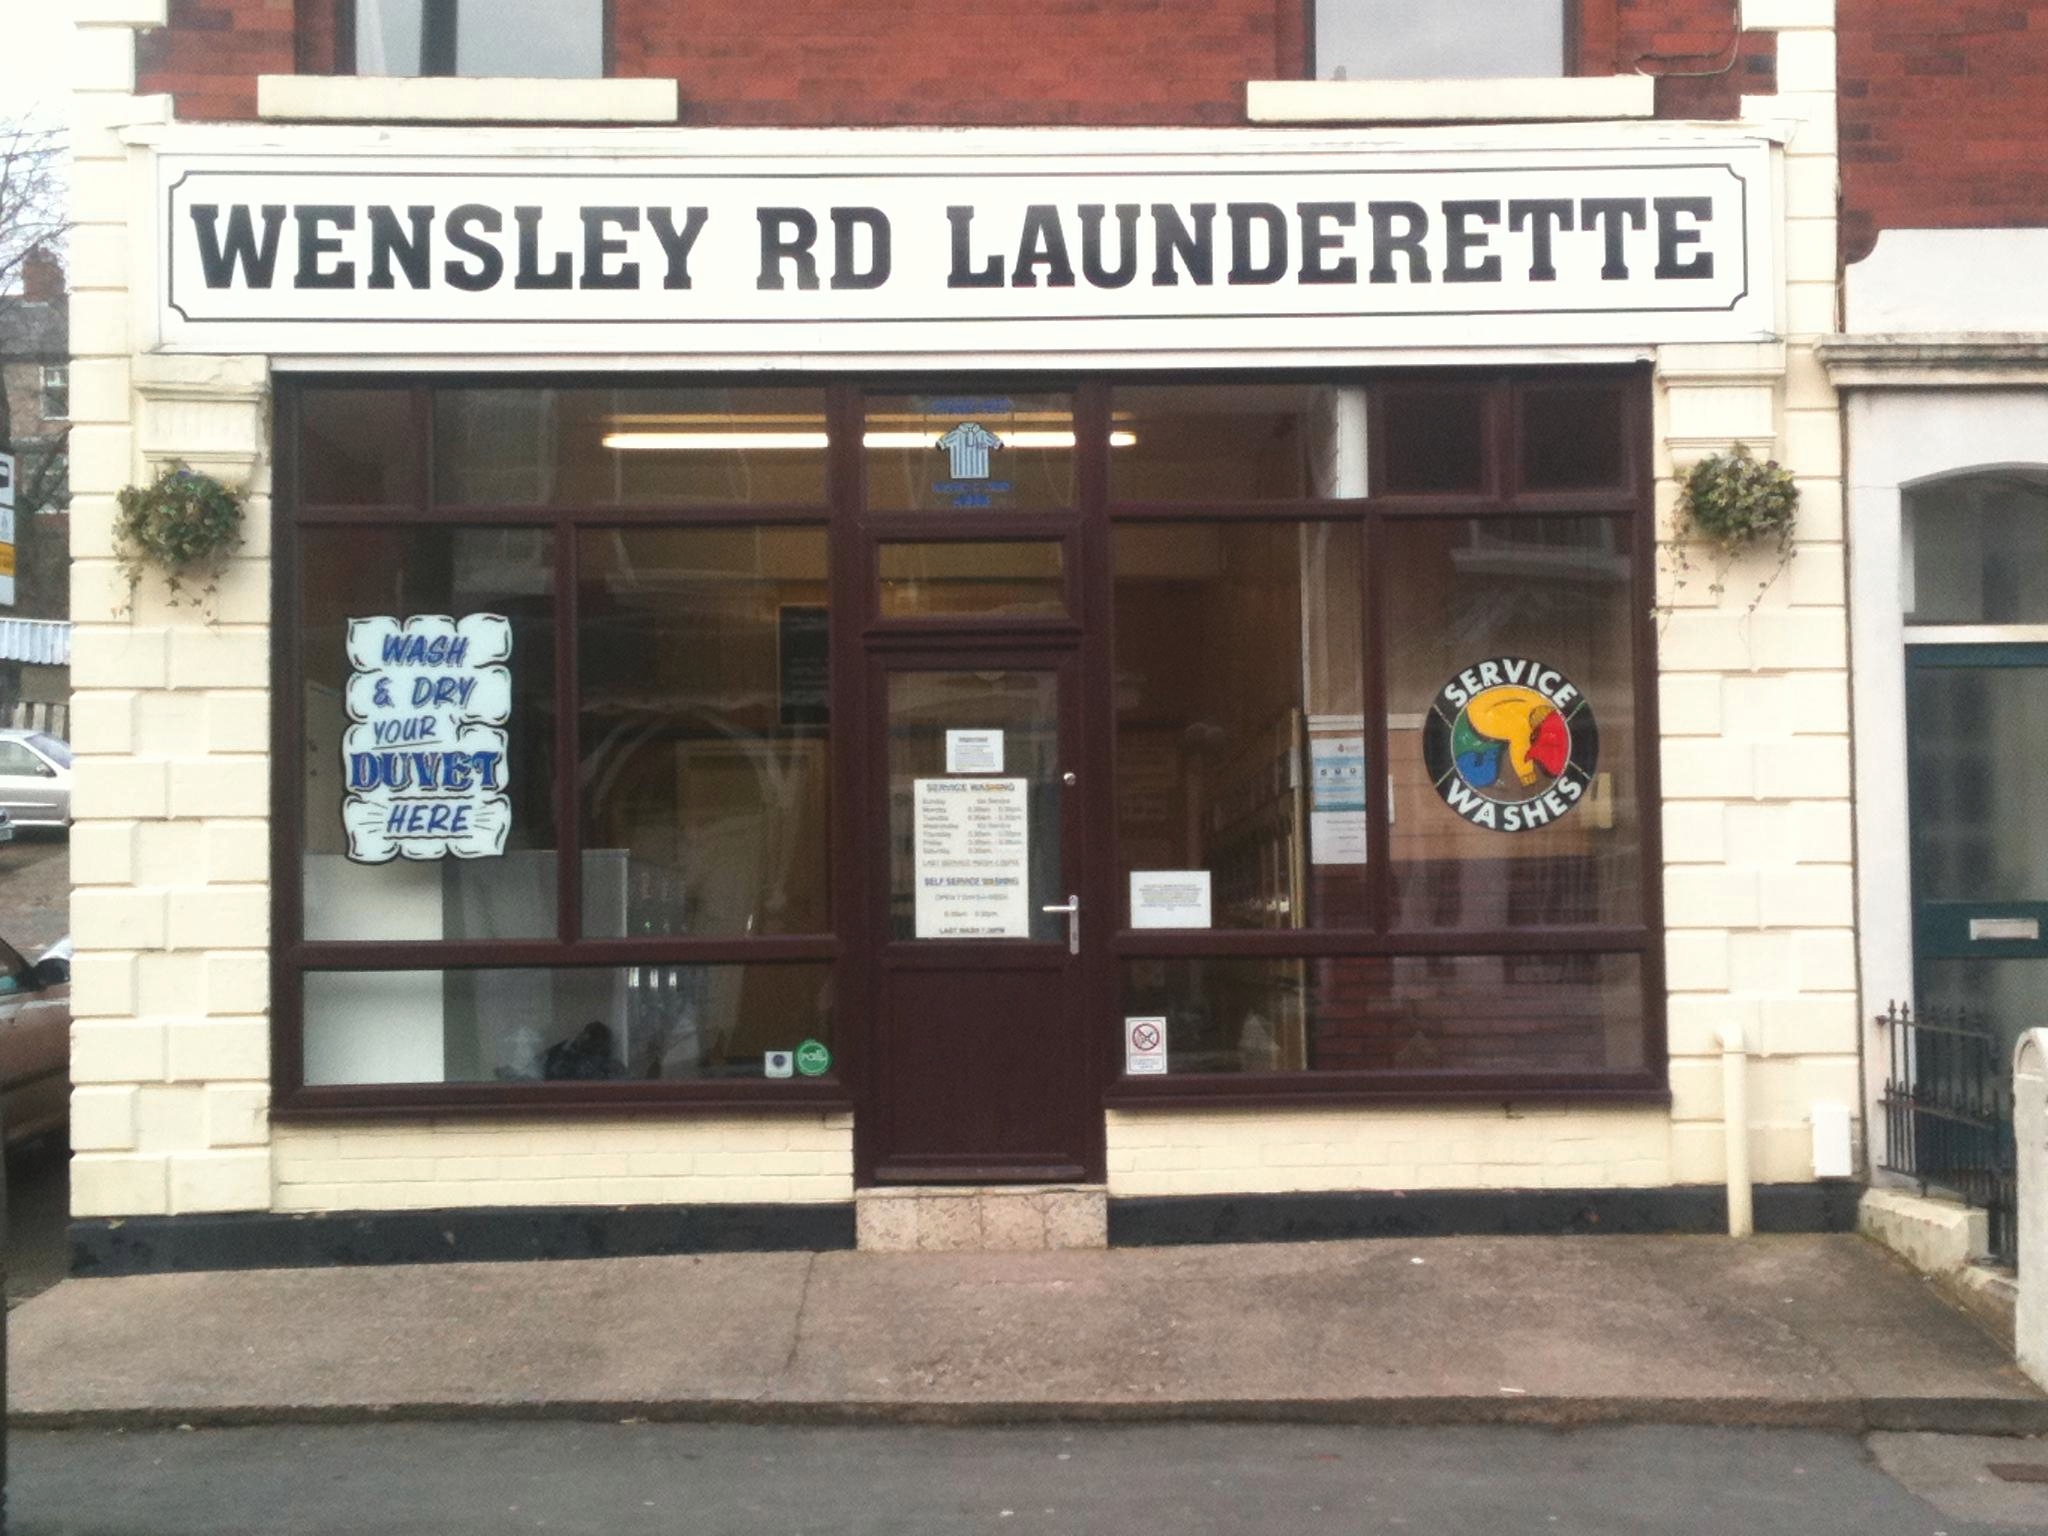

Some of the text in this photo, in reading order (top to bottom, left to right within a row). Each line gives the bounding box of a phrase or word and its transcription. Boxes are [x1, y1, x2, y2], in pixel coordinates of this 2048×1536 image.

[190, 196, 1715, 292] WENSLEY RD LAUNDERETTE
[382, 633, 470, 668] WASH
[372, 676, 477, 709] & DRY
[1444, 658, 1578, 708] SERVICE
[374, 716, 437, 745] YOUR
[350, 751, 502, 792] DUVET
[926, 783, 1015, 792] SERVICE WASHING
[386, 804, 472, 832] HERE
[1446, 776, 1582, 832] WASHES
